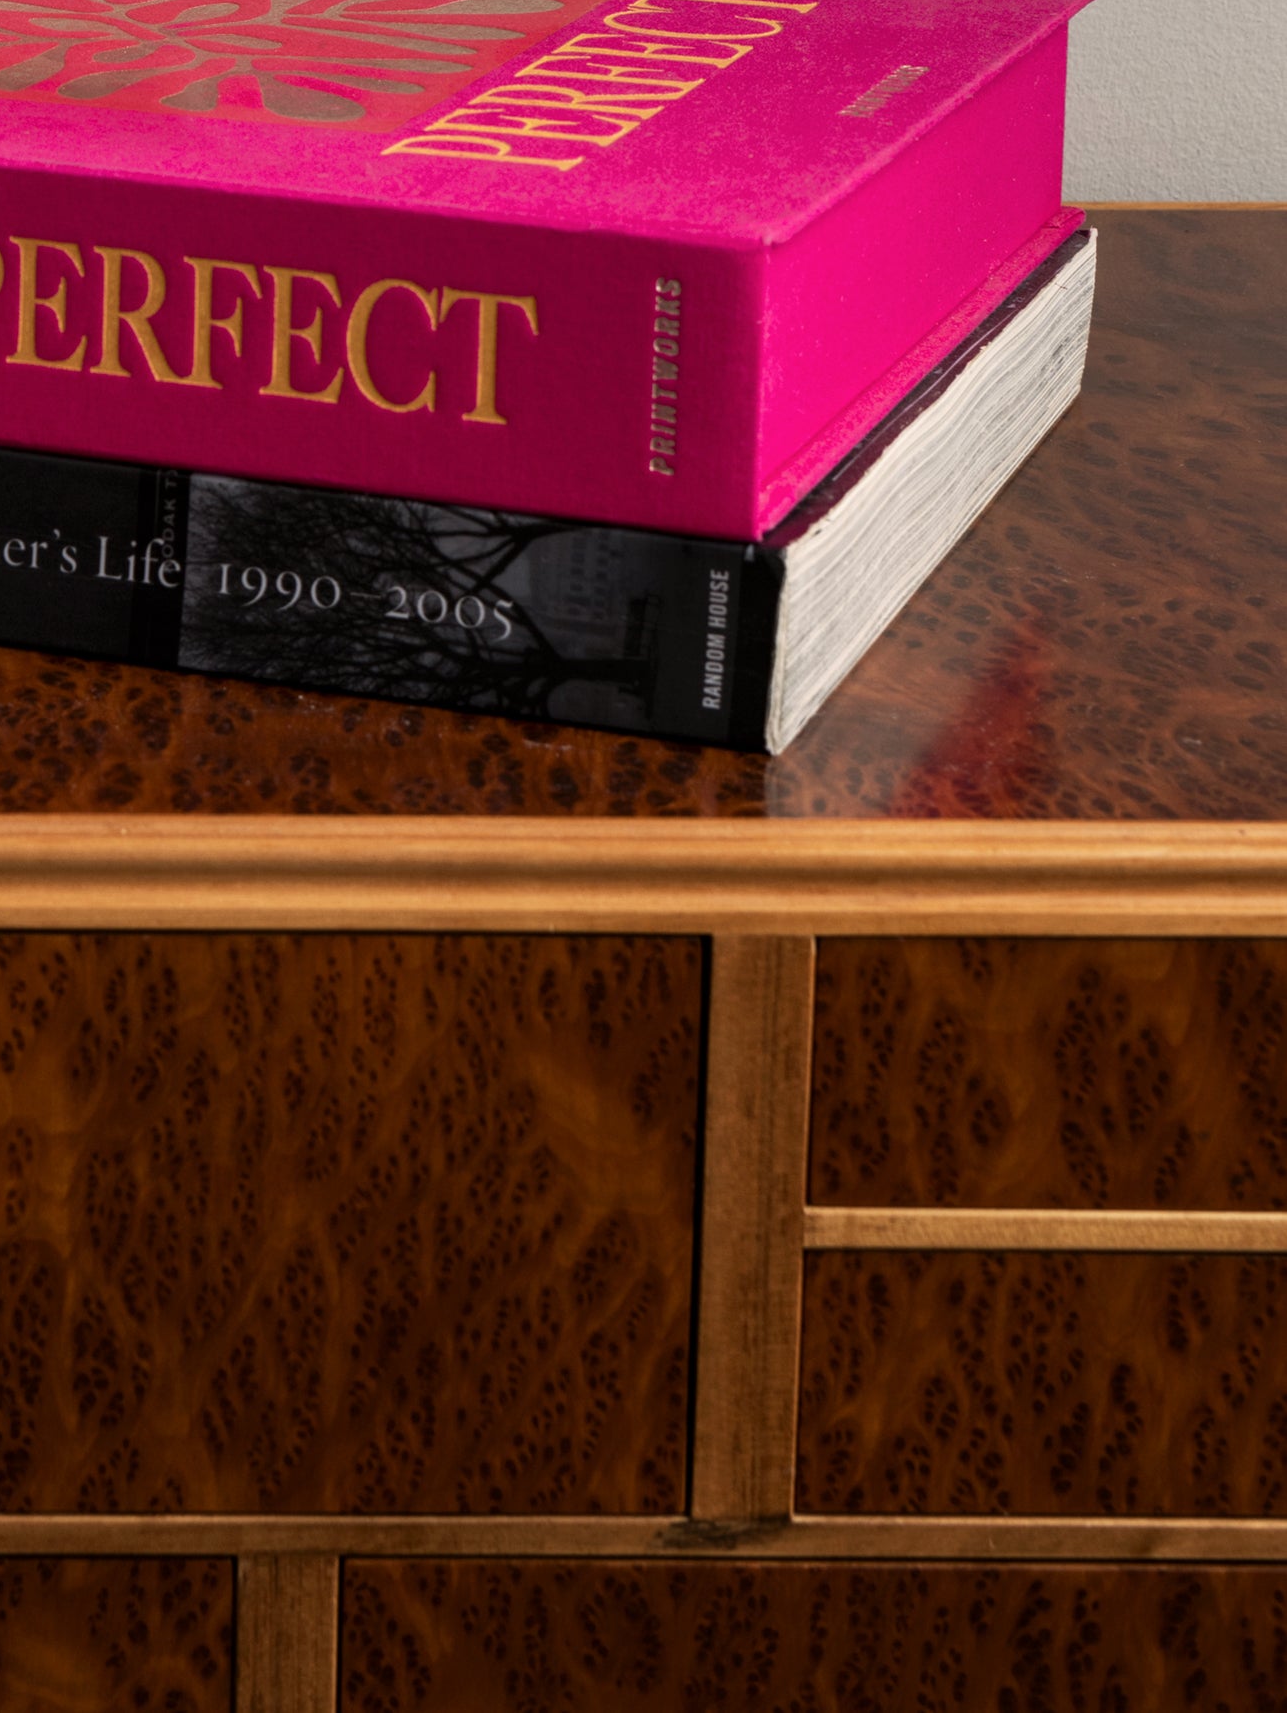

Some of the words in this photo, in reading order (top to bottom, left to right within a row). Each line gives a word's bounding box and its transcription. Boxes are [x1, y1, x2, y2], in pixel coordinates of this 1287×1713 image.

[648, 276, 682, 477] PRINTWORKS
[95, 535, 182, 588] Life
[708, 569, 729, 628] HOUSE
[701, 633, 726, 710] RANDOM
